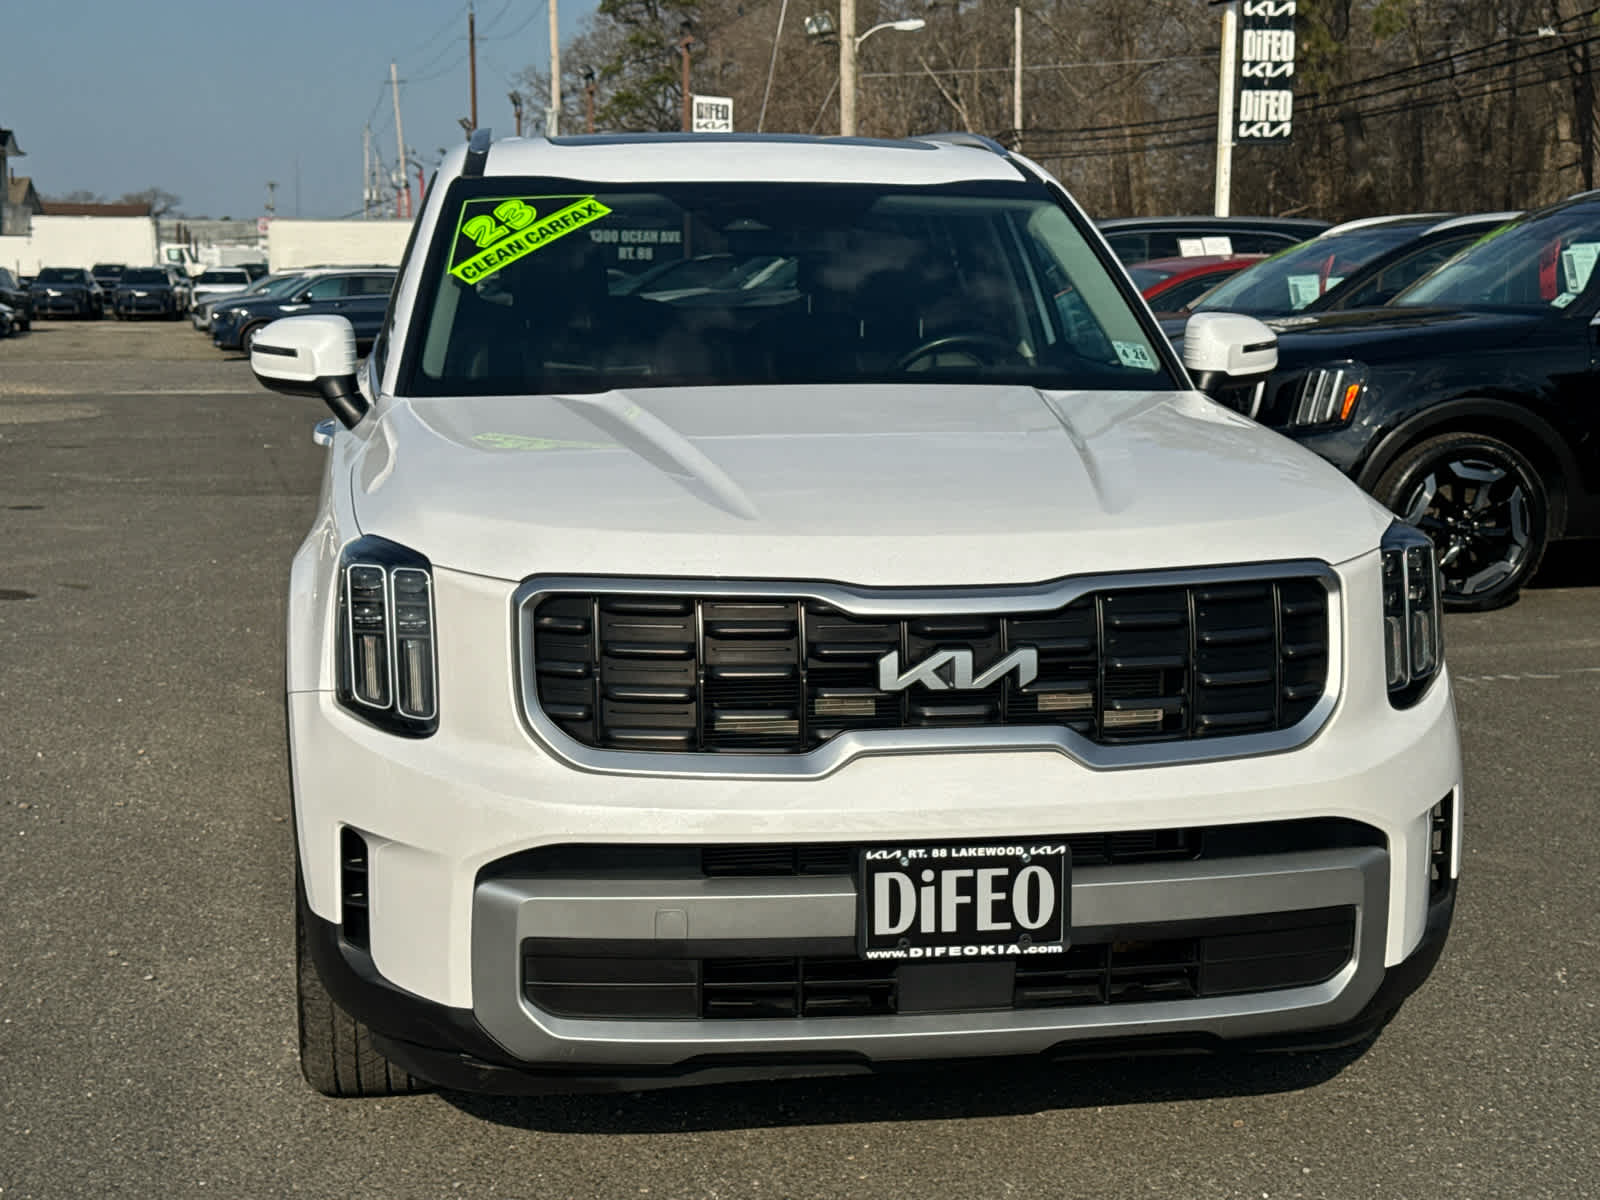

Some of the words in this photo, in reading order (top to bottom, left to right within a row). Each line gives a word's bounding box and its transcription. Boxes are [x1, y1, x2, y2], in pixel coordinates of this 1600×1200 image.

[1241, 62, 1294, 77] KIA
[1239, 121, 1291, 137] KIA
[462, 199, 537, 248] 23
[460, 239, 524, 279] CLEAN
[524, 202, 600, 245] CARFAX
[621, 229, 658, 243] OCEAN
[660, 230, 682, 243] AVE
[879, 648, 1039, 691] KIA
[865, 850, 902, 860] KIA
[908, 849, 928, 859] RT.
[932, 848, 947, 858] 88
[951, 847, 1024, 857] LAKEWOOD
[1030, 845, 1067, 855] KIA
[874, 865, 1055, 935] DiFEO
[866, 944, 1063, 960] www.DIFEOKIA.com
